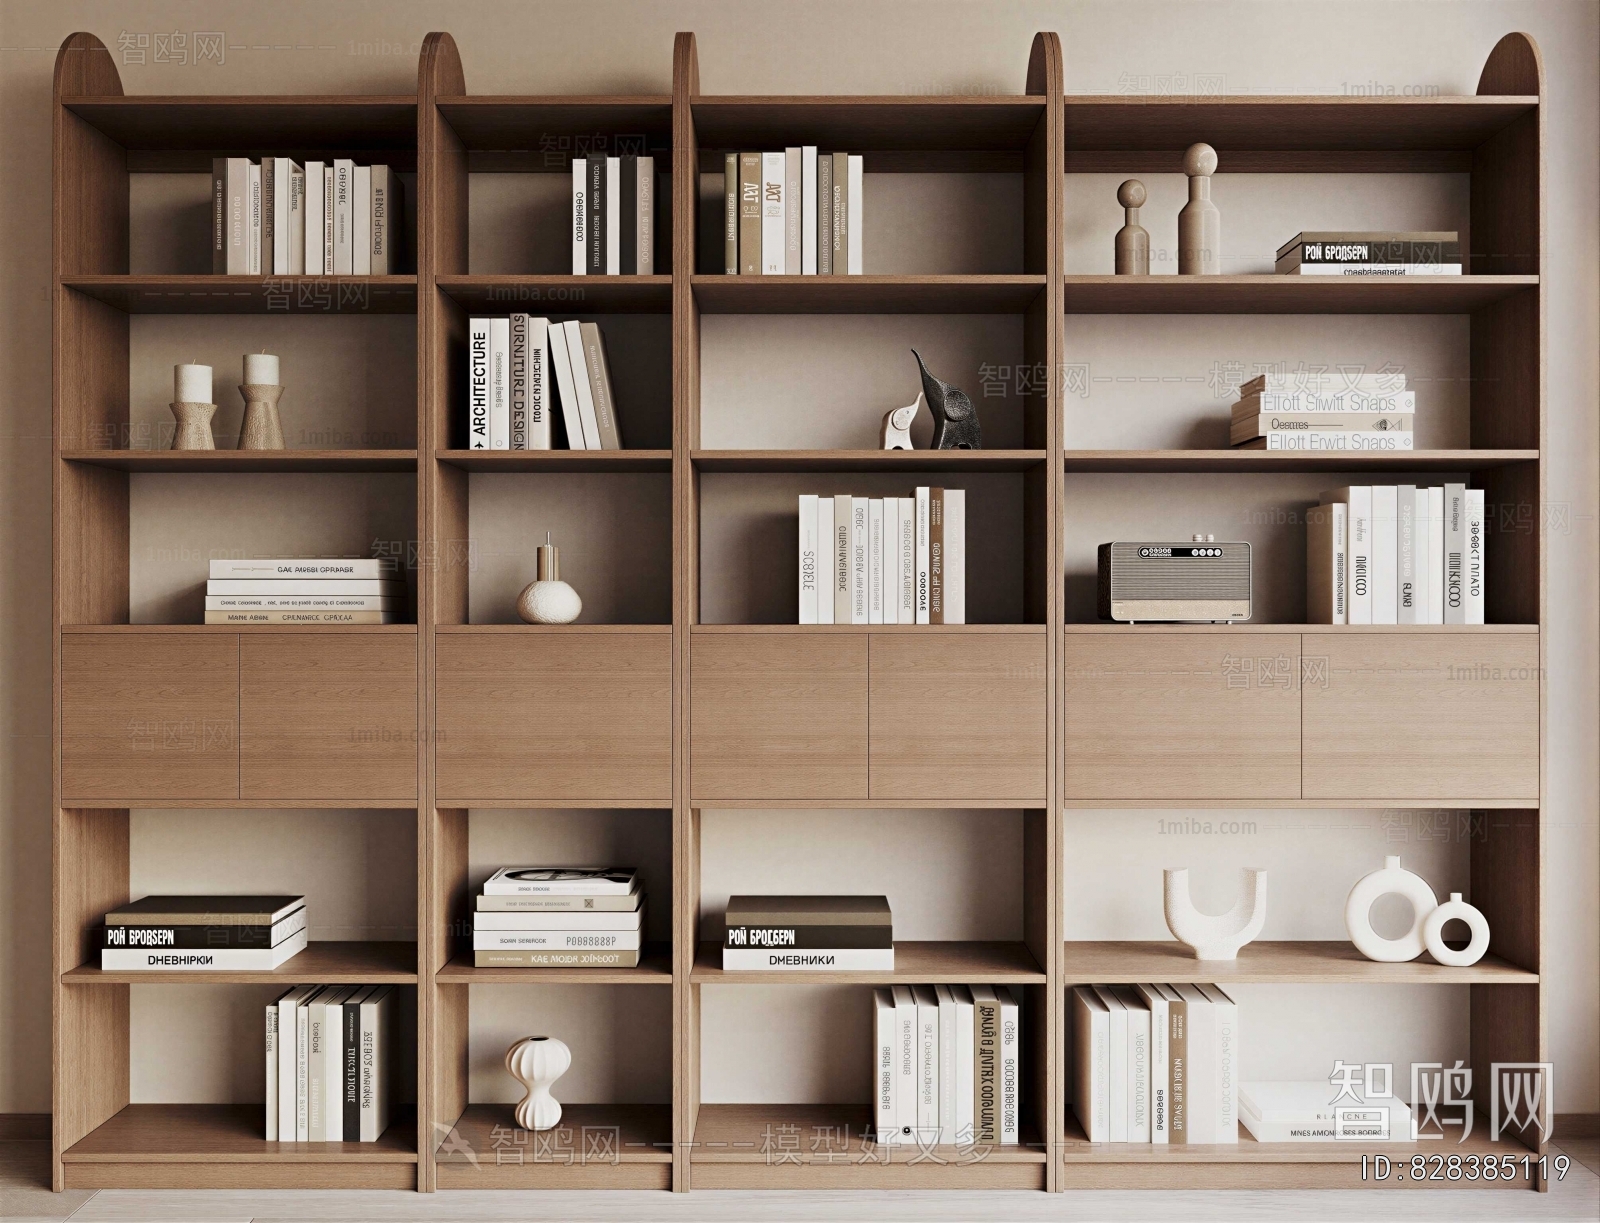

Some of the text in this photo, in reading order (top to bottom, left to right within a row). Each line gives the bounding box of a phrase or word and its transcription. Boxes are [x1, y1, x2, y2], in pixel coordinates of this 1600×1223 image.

[473, 332, 486, 436] ARCHITECTURE
[1350, 394, 1397, 414] Snaps
[1351, 433, 1396, 450] Snaps
